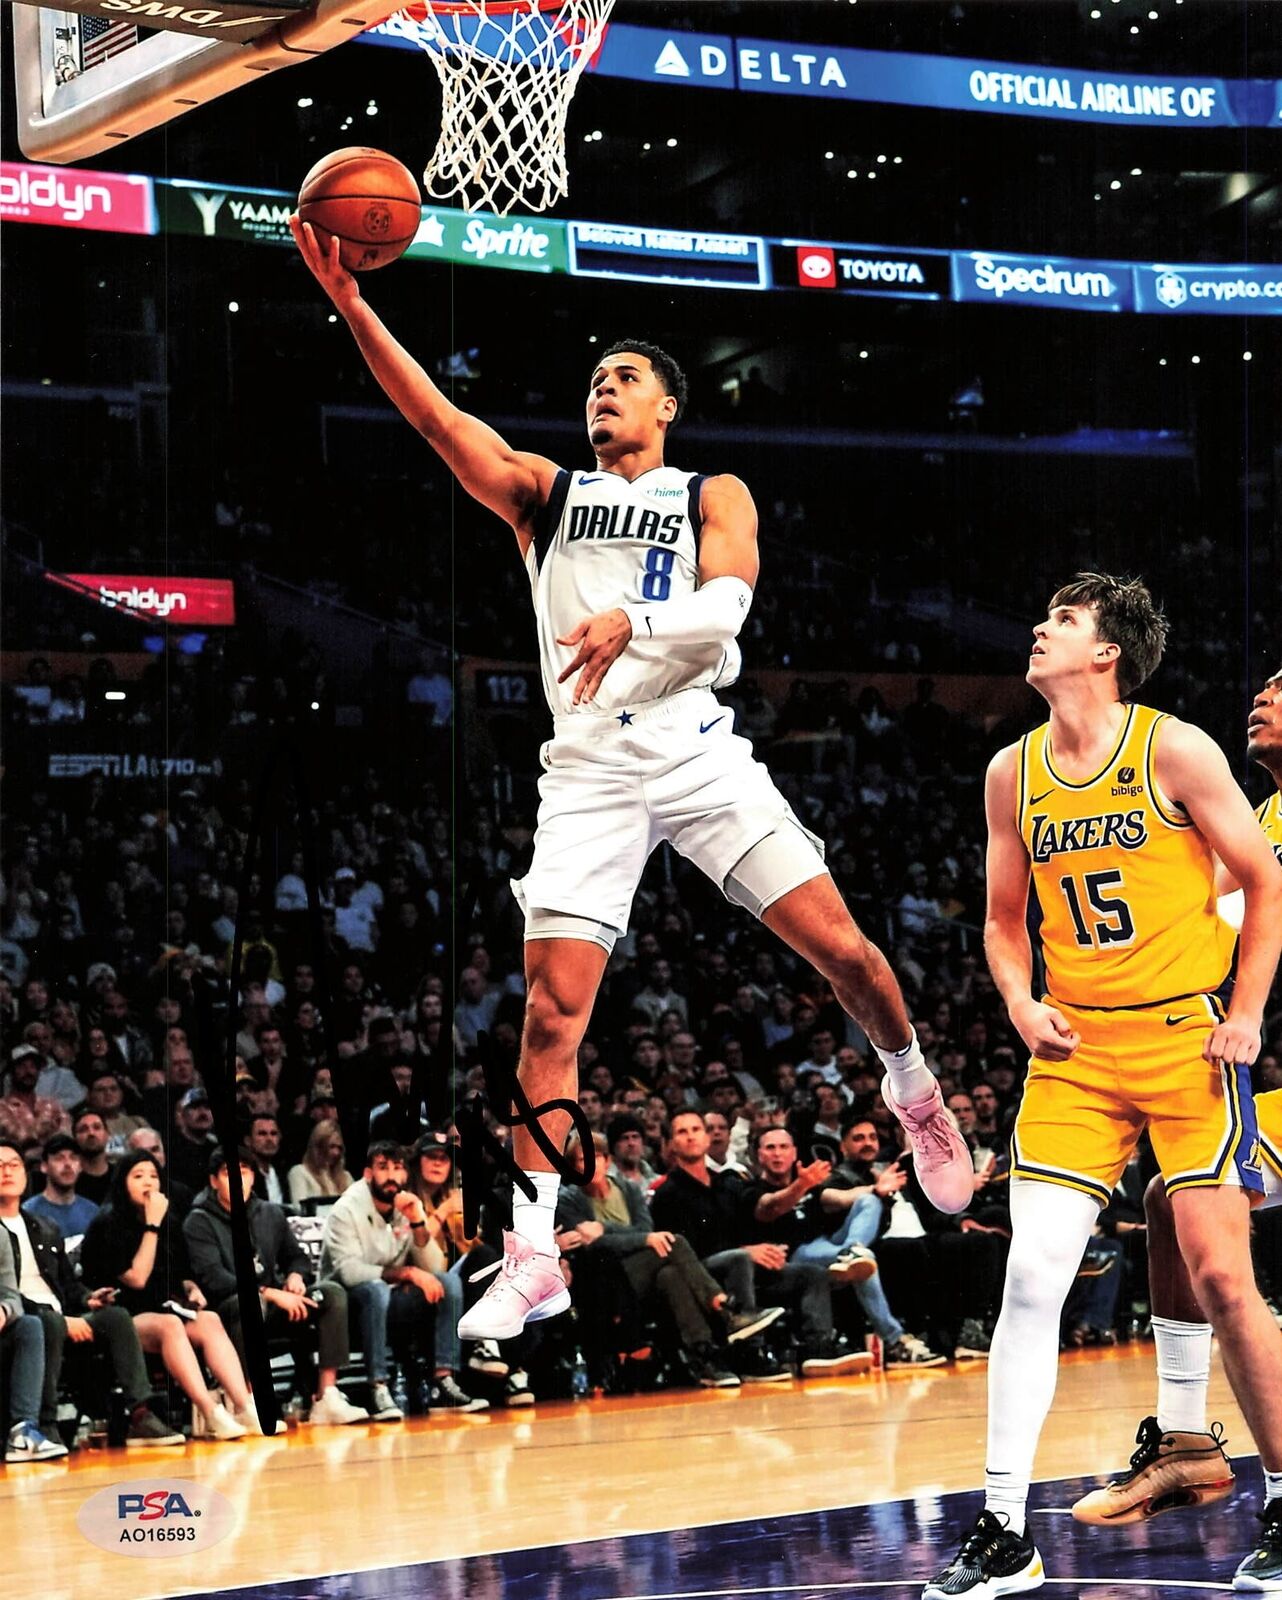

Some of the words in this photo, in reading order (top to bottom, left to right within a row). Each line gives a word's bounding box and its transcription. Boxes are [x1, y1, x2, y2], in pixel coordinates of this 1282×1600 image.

[700, 45, 847, 88] DELTA
[969, 70, 1077, 109] OFFICIAL
[1081, 81, 1177, 117] AIRLINE
[1180, 87, 1216, 117] OF
[228, 200, 292, 224] YAAM
[462, 219, 550, 259] Sprite
[838, 258, 924, 283] TOYOTA
[974, 258, 1111, 298] Spectrum
[567, 504, 684, 545] DALLAS
[642, 546, 676, 602] 8
[487, 675, 529, 703] 112
[1111, 784, 1144, 797] bibigo
[1030, 809, 1149, 864] LAKERS
[1059, 868, 1137, 951] 15
